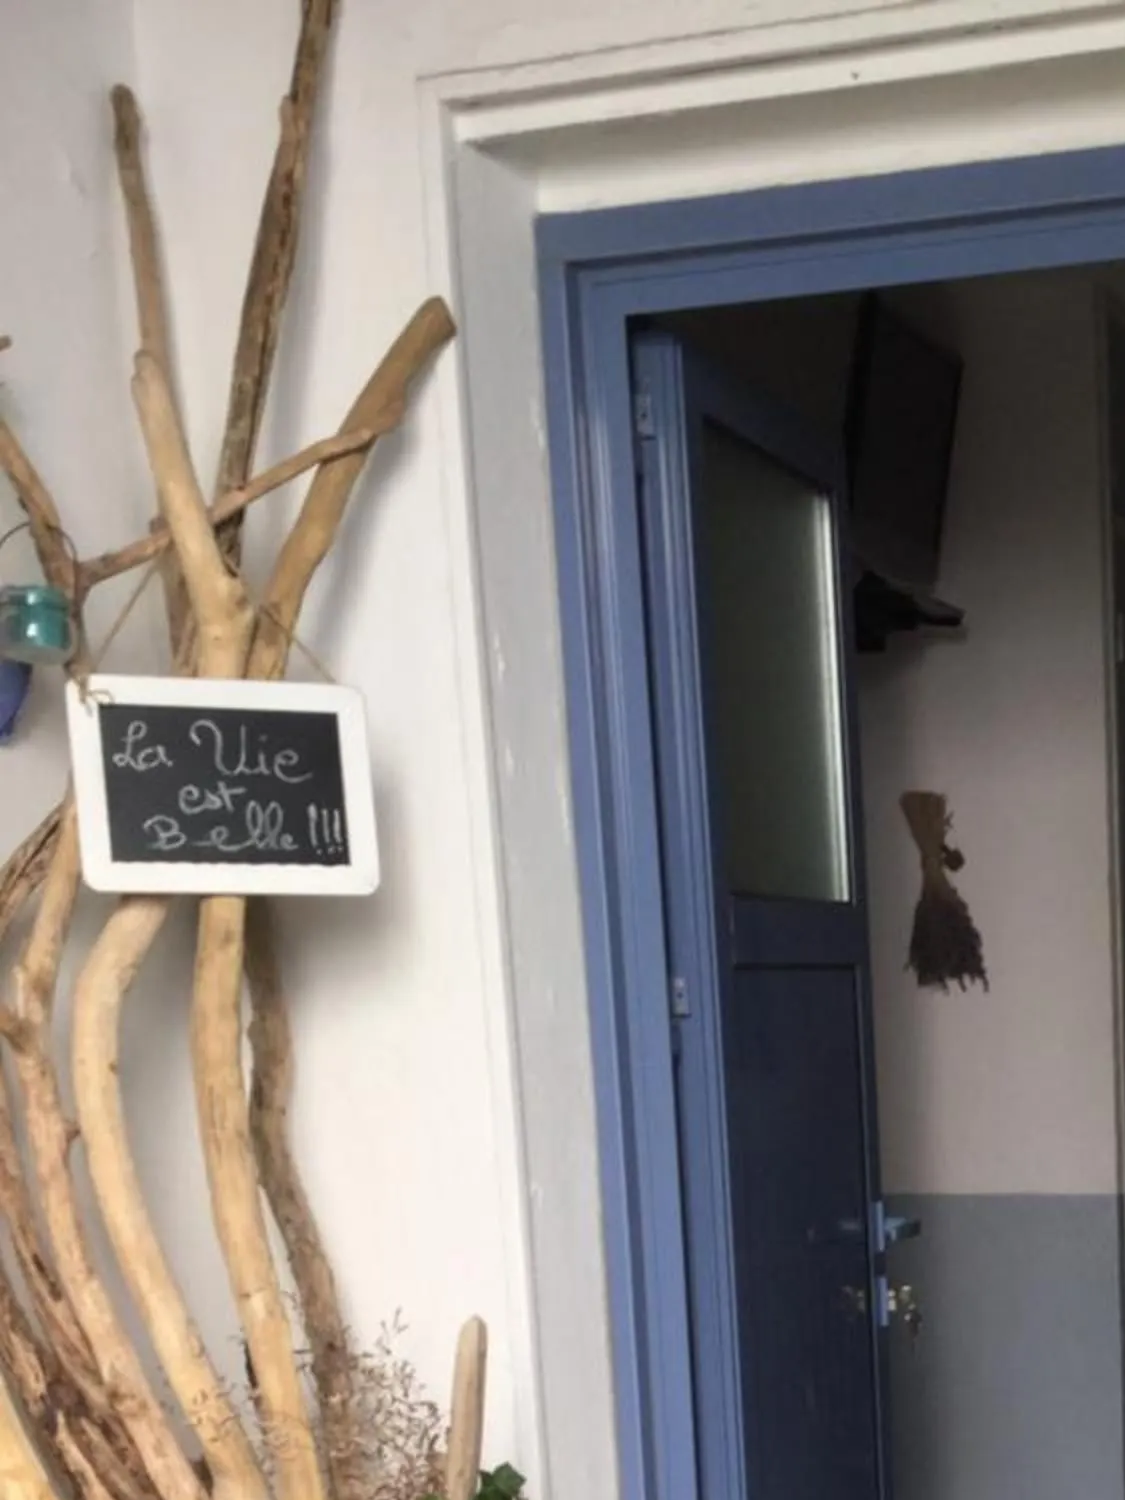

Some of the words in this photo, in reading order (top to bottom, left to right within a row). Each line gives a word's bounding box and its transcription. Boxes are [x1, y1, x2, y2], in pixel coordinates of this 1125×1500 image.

[112, 720, 173, 771] La
[189, 719, 313, 783] Vie
[178, 780, 246, 815] est
